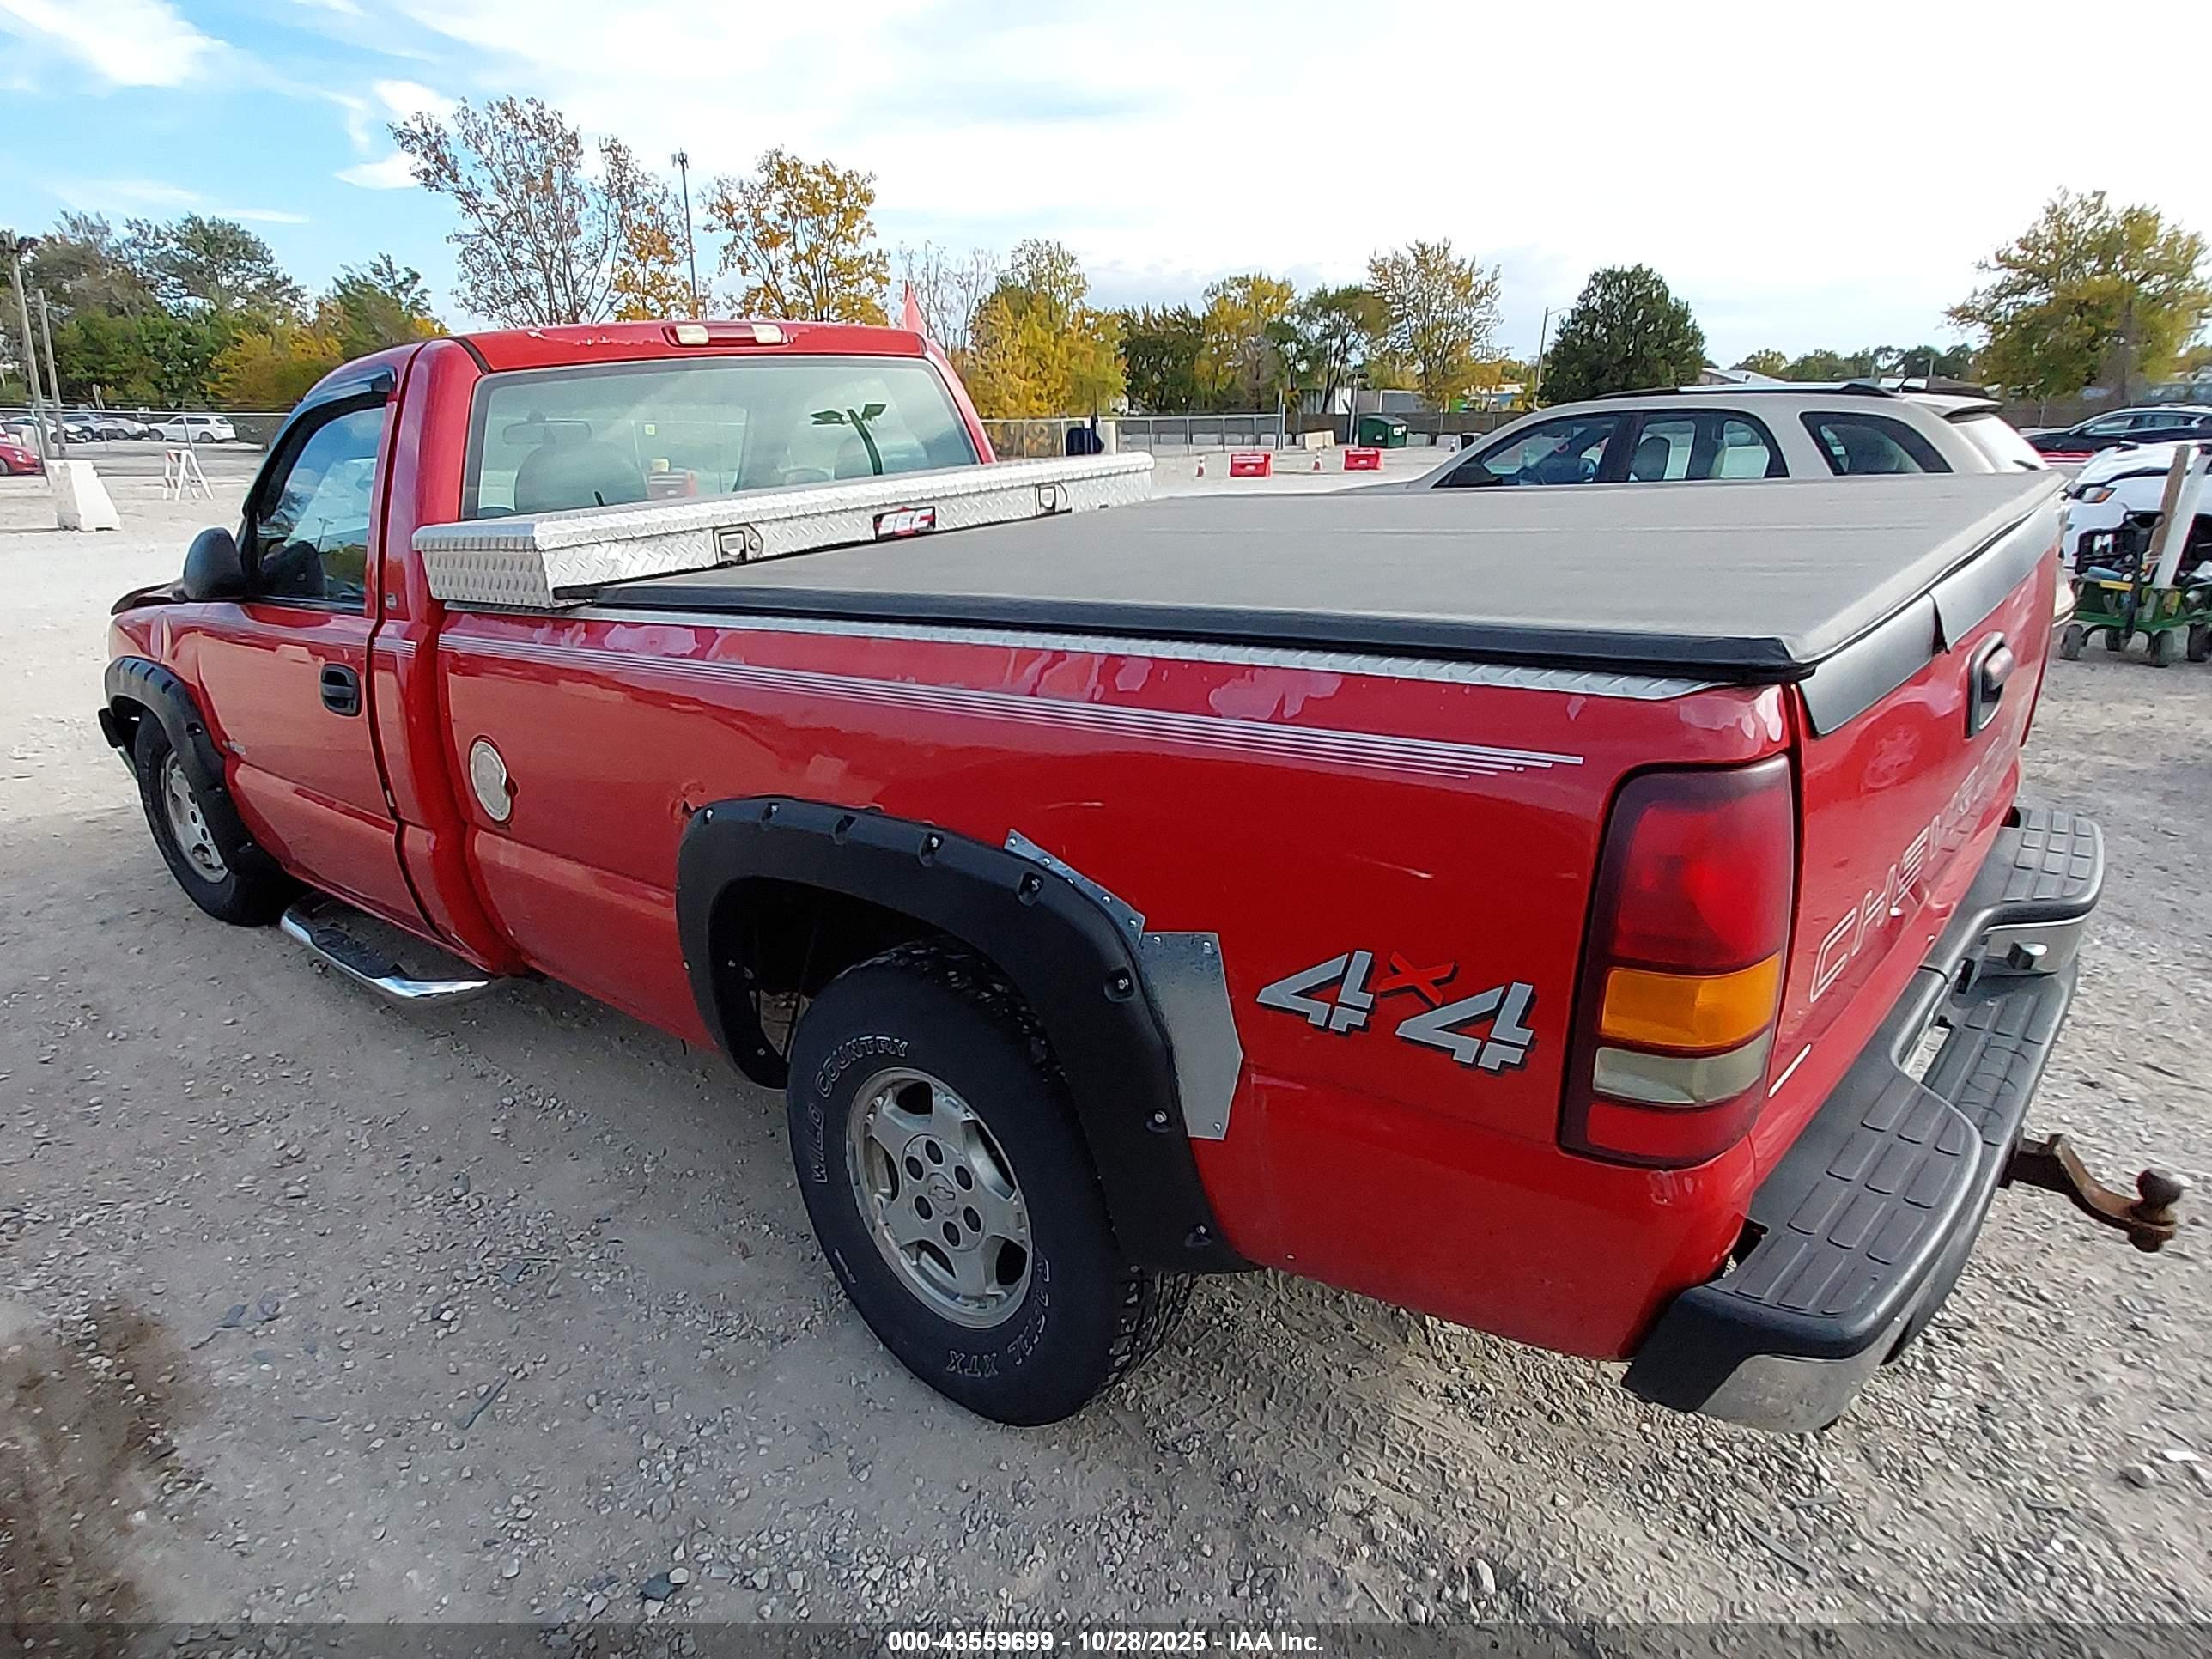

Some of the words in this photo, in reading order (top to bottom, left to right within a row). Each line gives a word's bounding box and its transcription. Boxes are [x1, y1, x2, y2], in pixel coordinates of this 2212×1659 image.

[815, 1035, 908, 1097] COUNTRY
[811, 1104, 830, 1183] WILD
[946, 1350, 999, 1378] XTX
